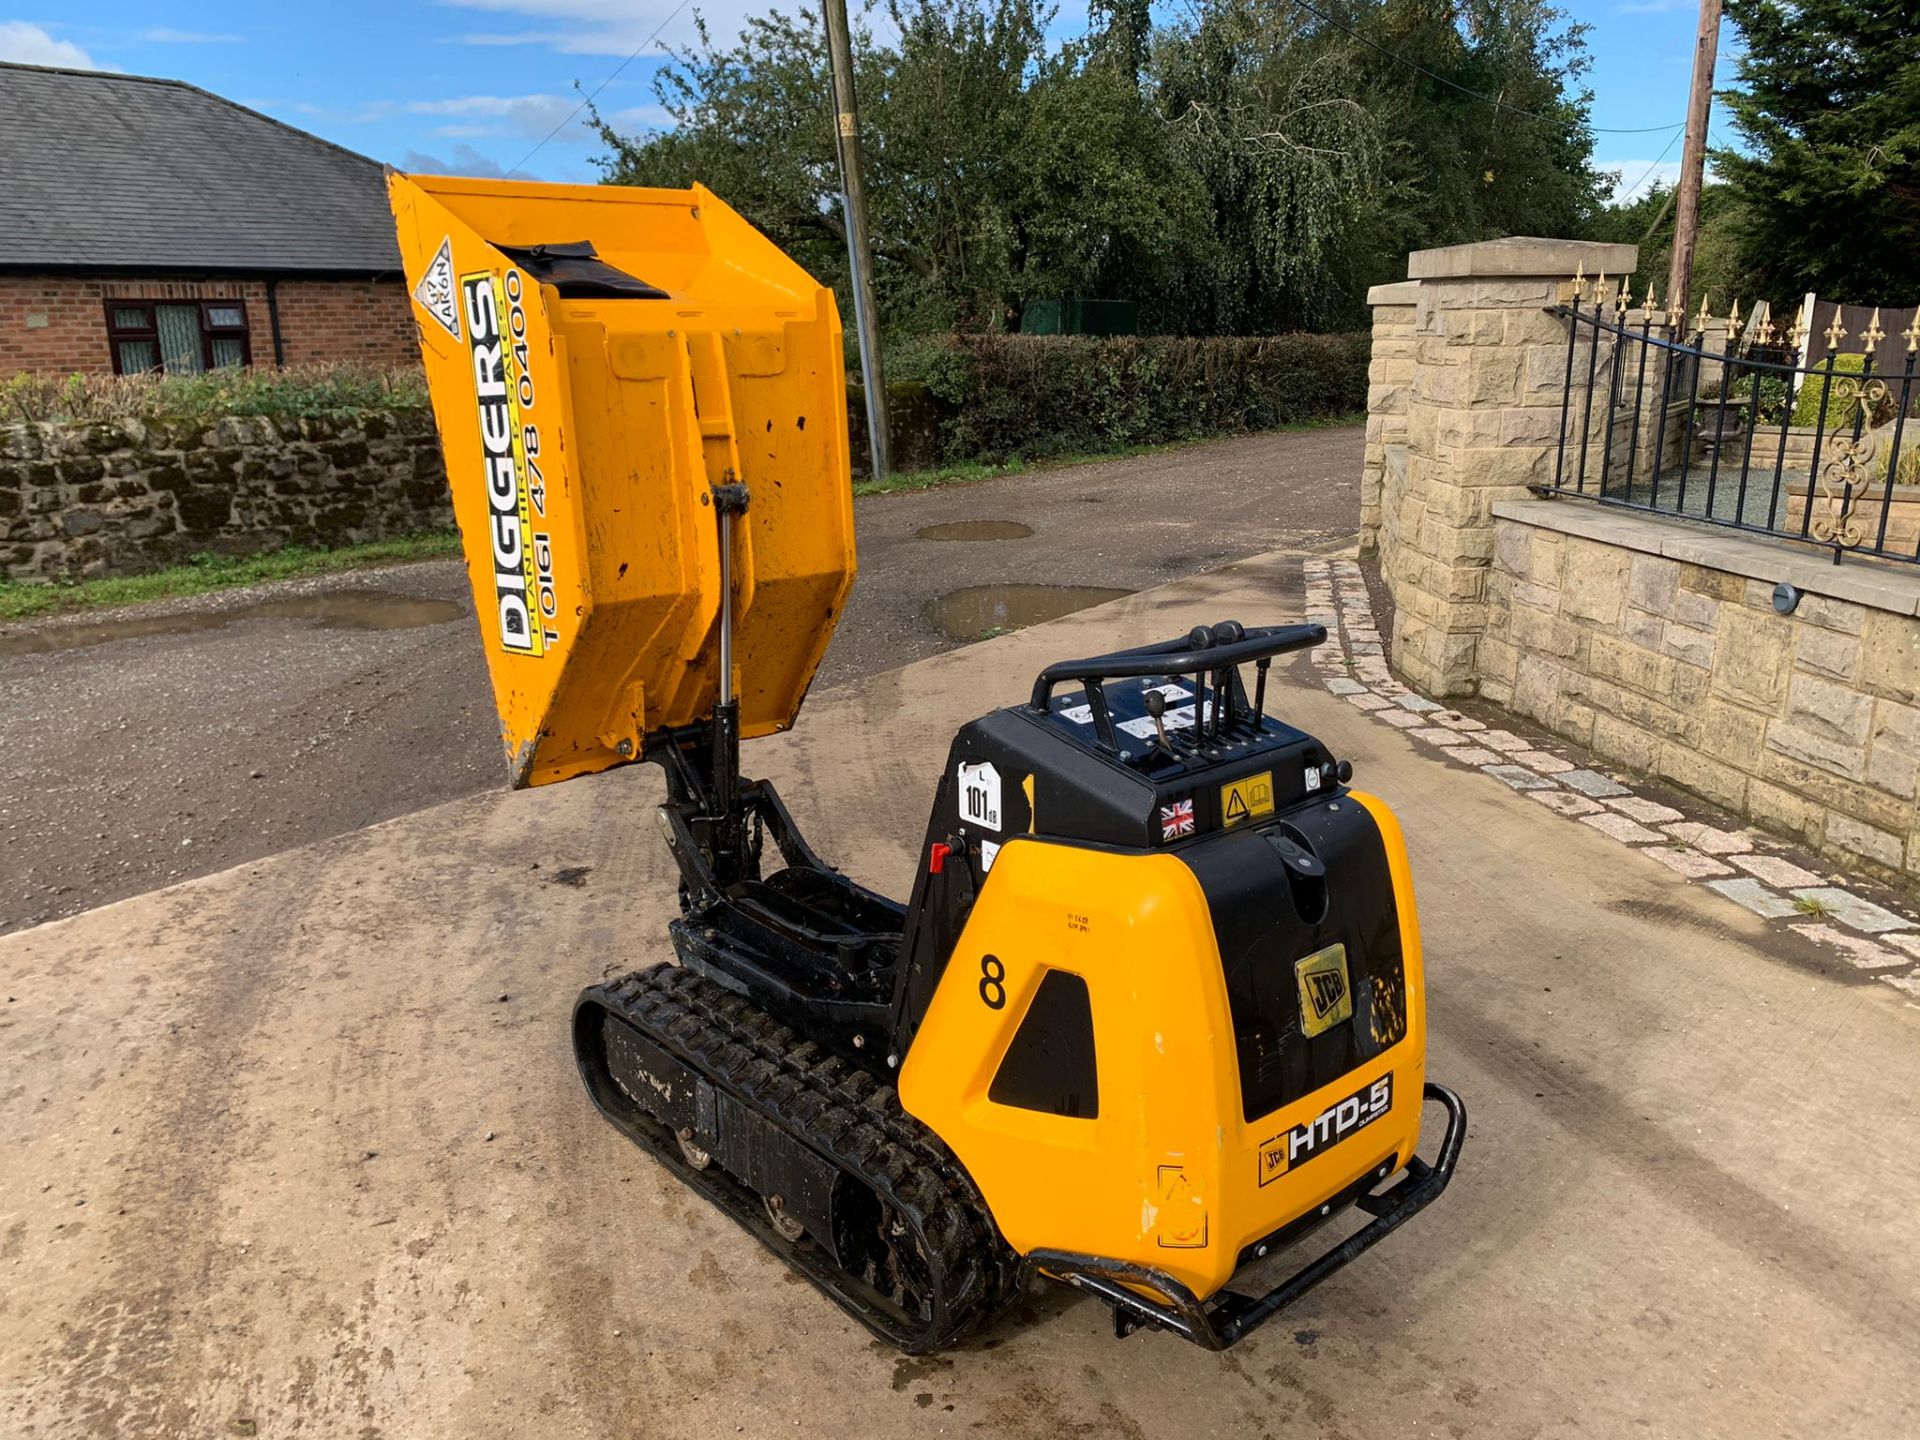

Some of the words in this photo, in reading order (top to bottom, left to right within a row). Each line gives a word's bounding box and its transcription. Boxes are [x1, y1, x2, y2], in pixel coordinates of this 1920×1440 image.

[496, 298, 516, 404] SALES
[506, 269, 534, 408] 0400
[464, 280, 532, 648] DIGGERS
[514, 455, 529, 524] HIRE
[525, 425, 545, 515] 478
[522, 538, 539, 634] PLANT
[535, 534, 556, 616] 0161
[966, 784, 988, 821] 101
[979, 953, 1007, 1011] 8
[1312, 971, 1344, 1013] JCB
[1289, 1076, 1390, 1161] HTD-5
